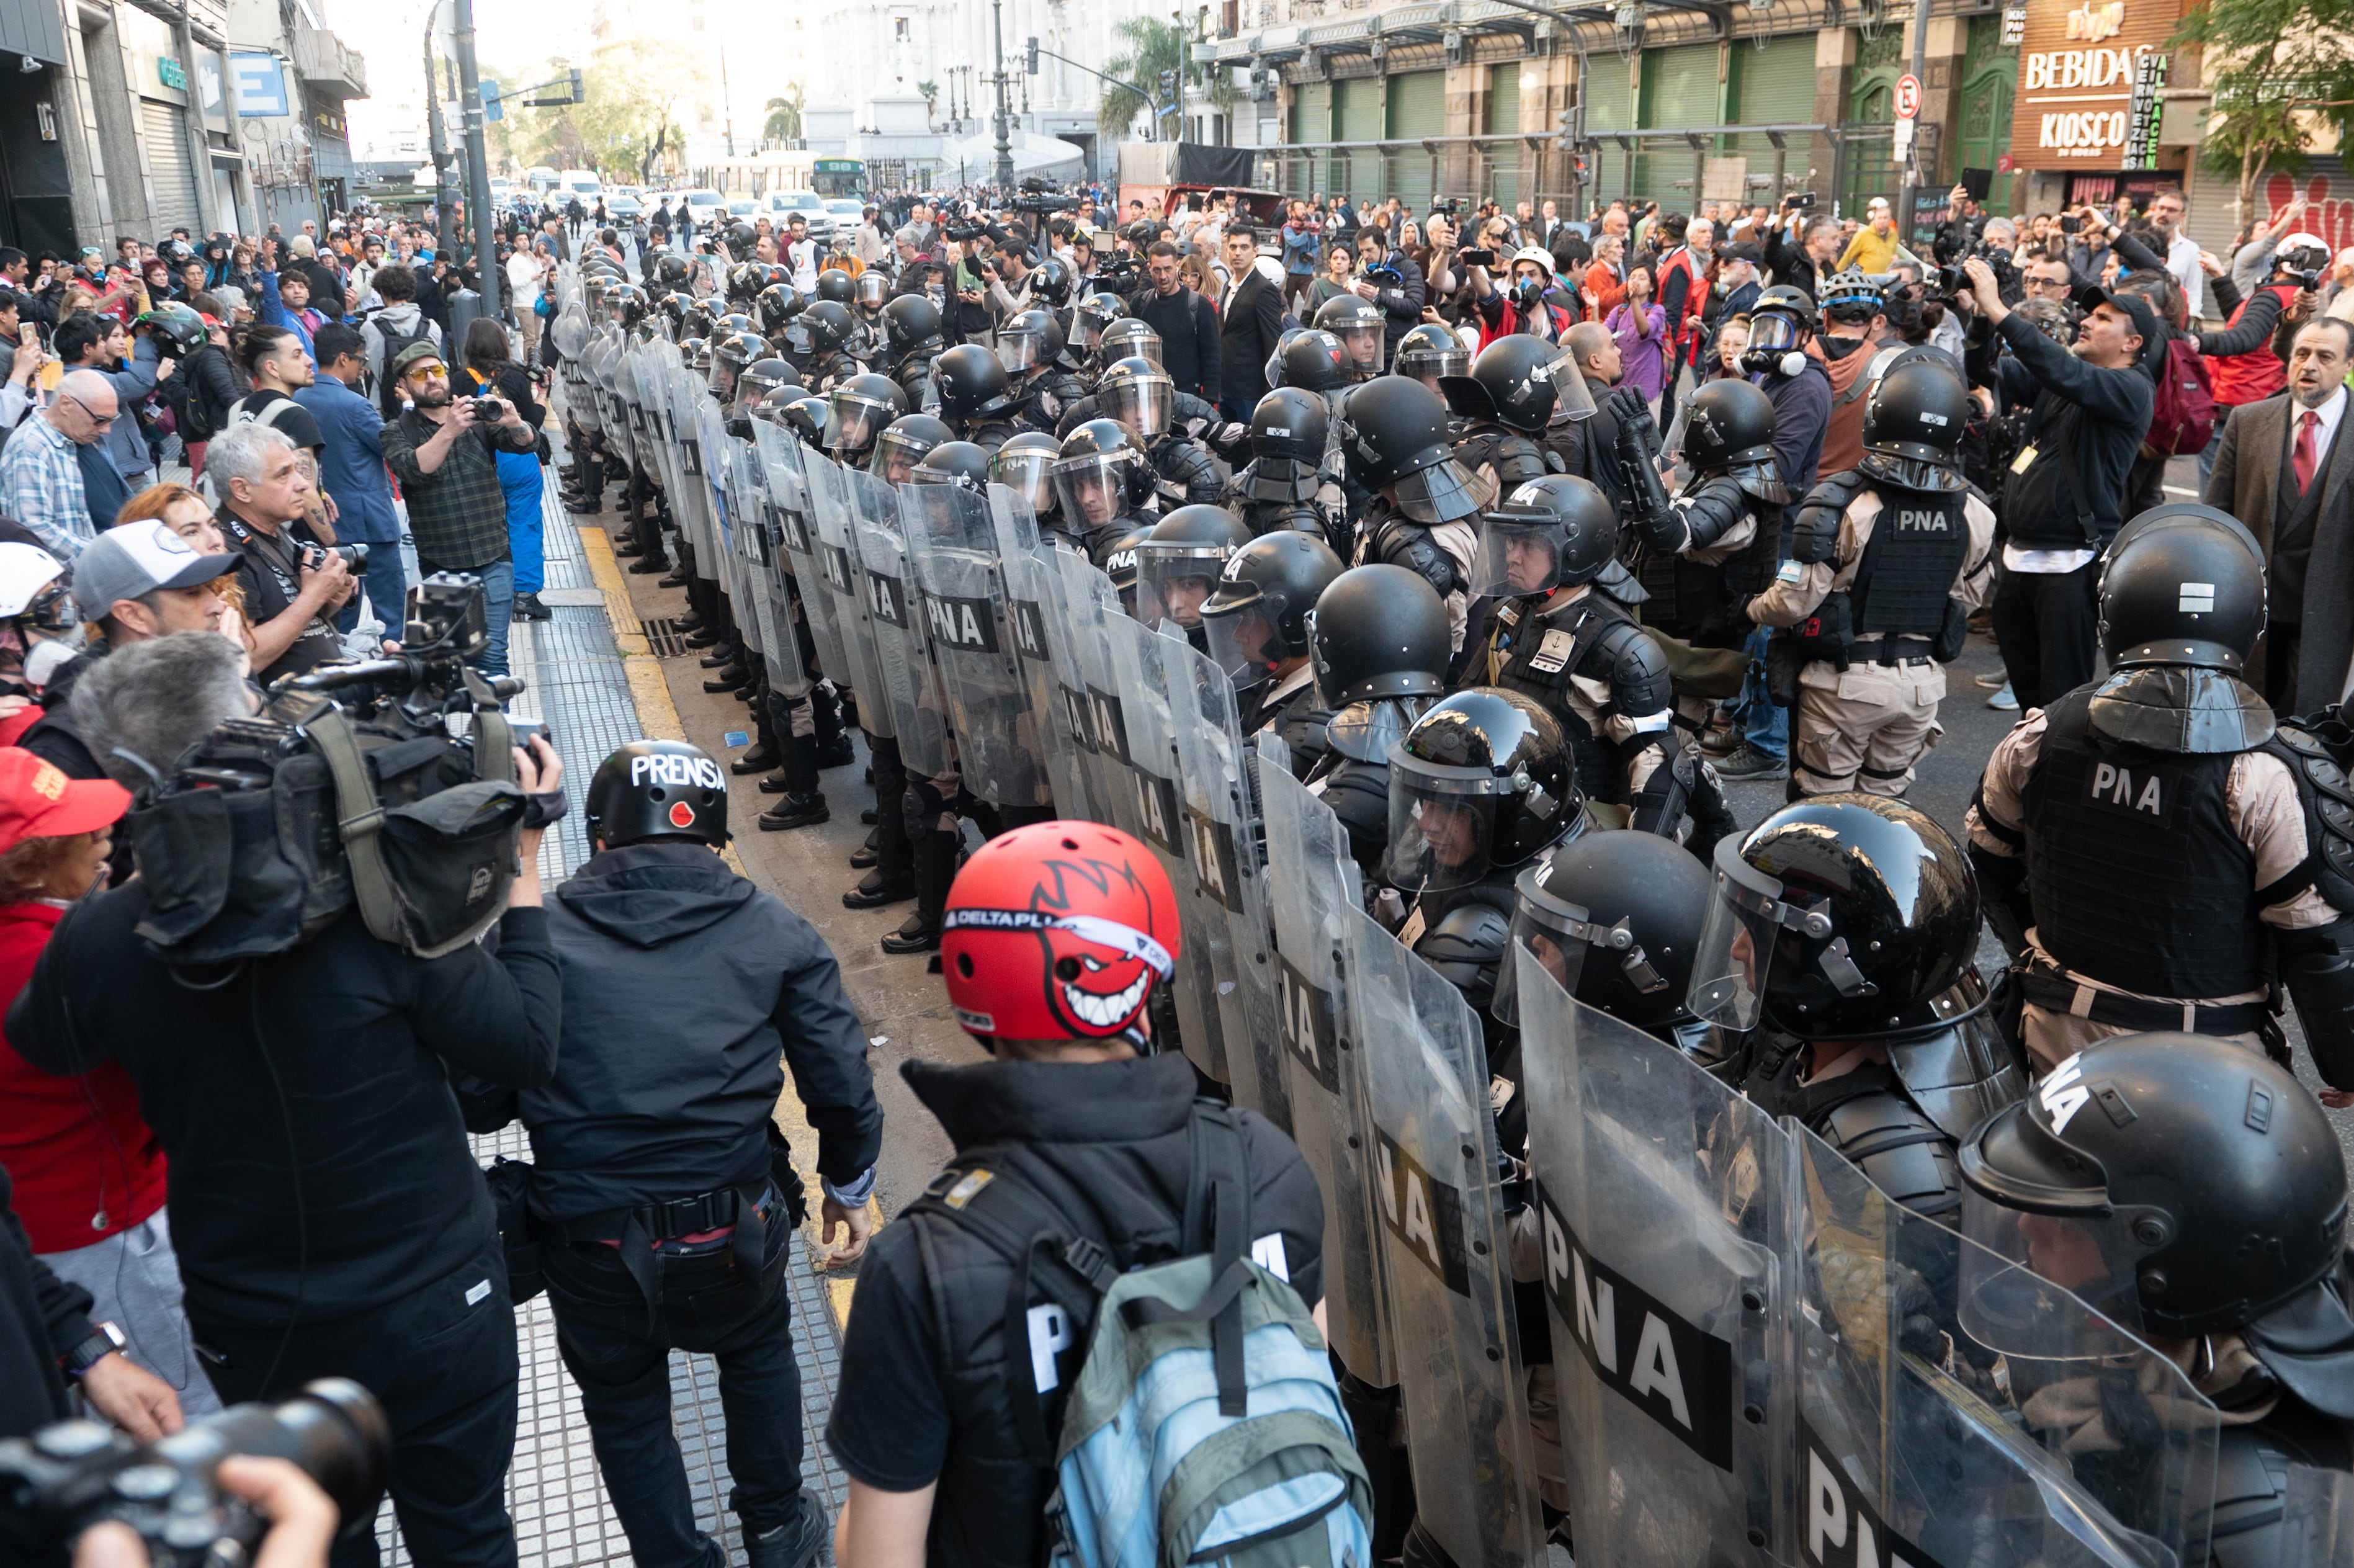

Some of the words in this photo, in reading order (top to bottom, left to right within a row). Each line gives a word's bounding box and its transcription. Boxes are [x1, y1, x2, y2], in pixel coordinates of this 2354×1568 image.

[232, 58, 279, 110] E
[2039, 111, 2126, 148] KIOSCO
[1899, 510, 1948, 532] PNA
[1106, 549, 1137, 573] PNA
[924, 596, 985, 646] PNA
[631, 753, 727, 793] PRENSA
[2039, 1051, 2090, 1136] NA
[1542, 1200, 1693, 1432] PNA
